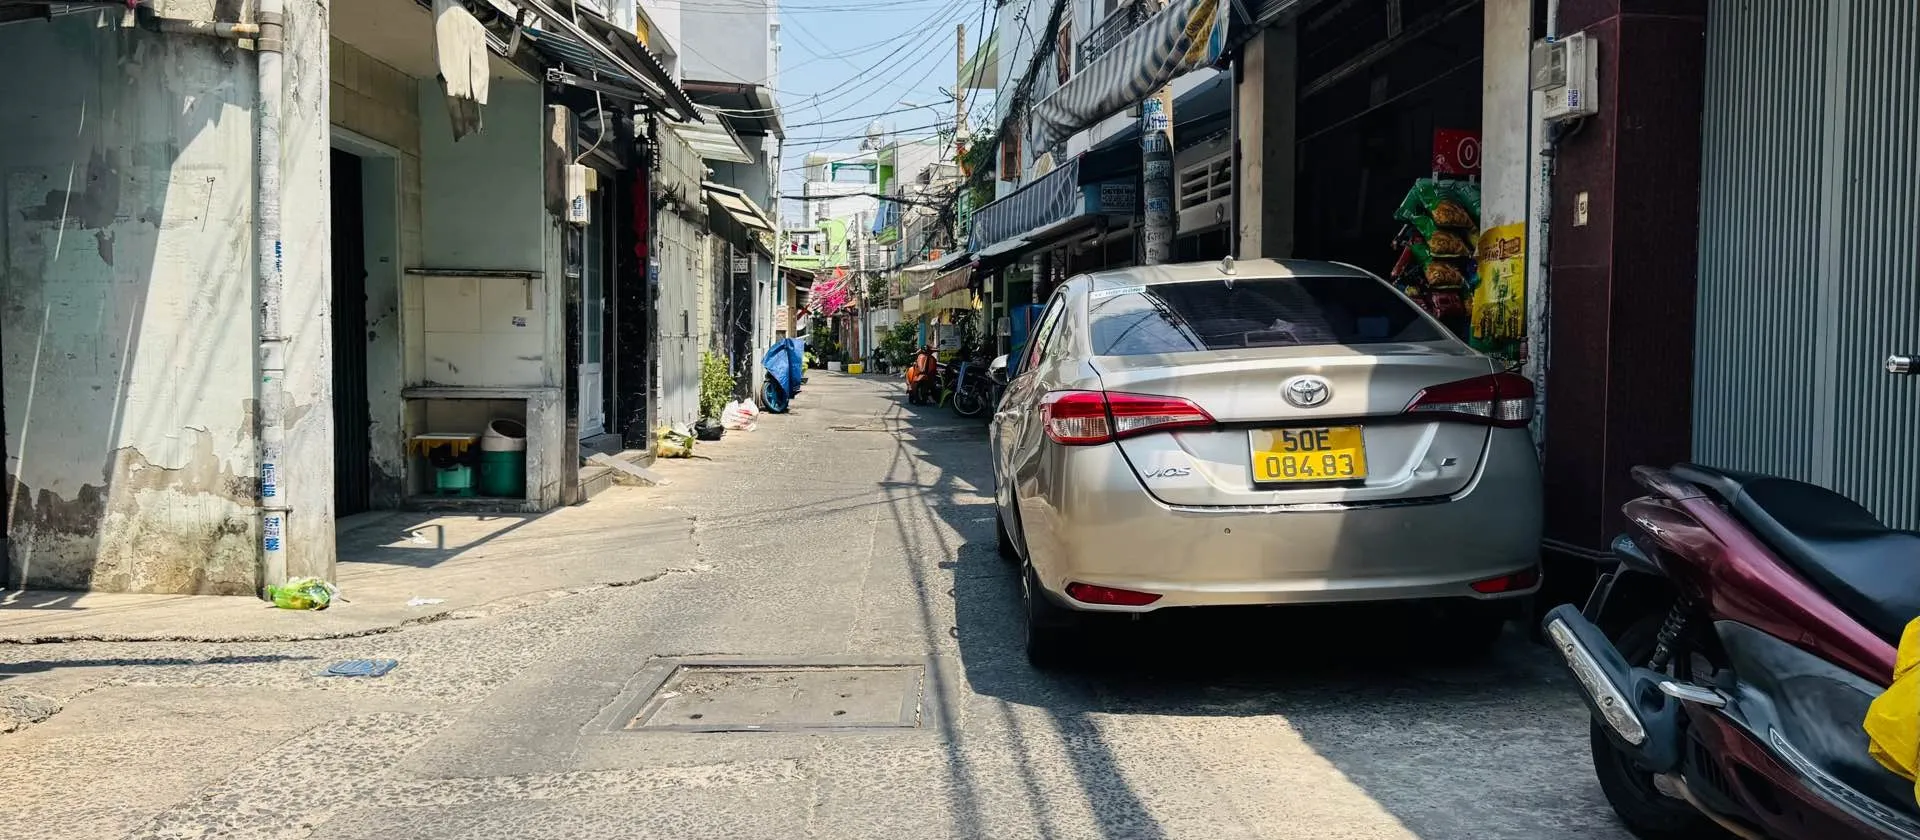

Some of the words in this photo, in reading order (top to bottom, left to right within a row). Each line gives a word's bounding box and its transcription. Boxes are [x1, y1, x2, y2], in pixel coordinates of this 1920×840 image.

[1457, 136, 1481, 169] O
[1282, 429, 1332, 452] 50E
[1265, 453, 1354, 478] 084.83
[1439, 457, 1457, 467] E
